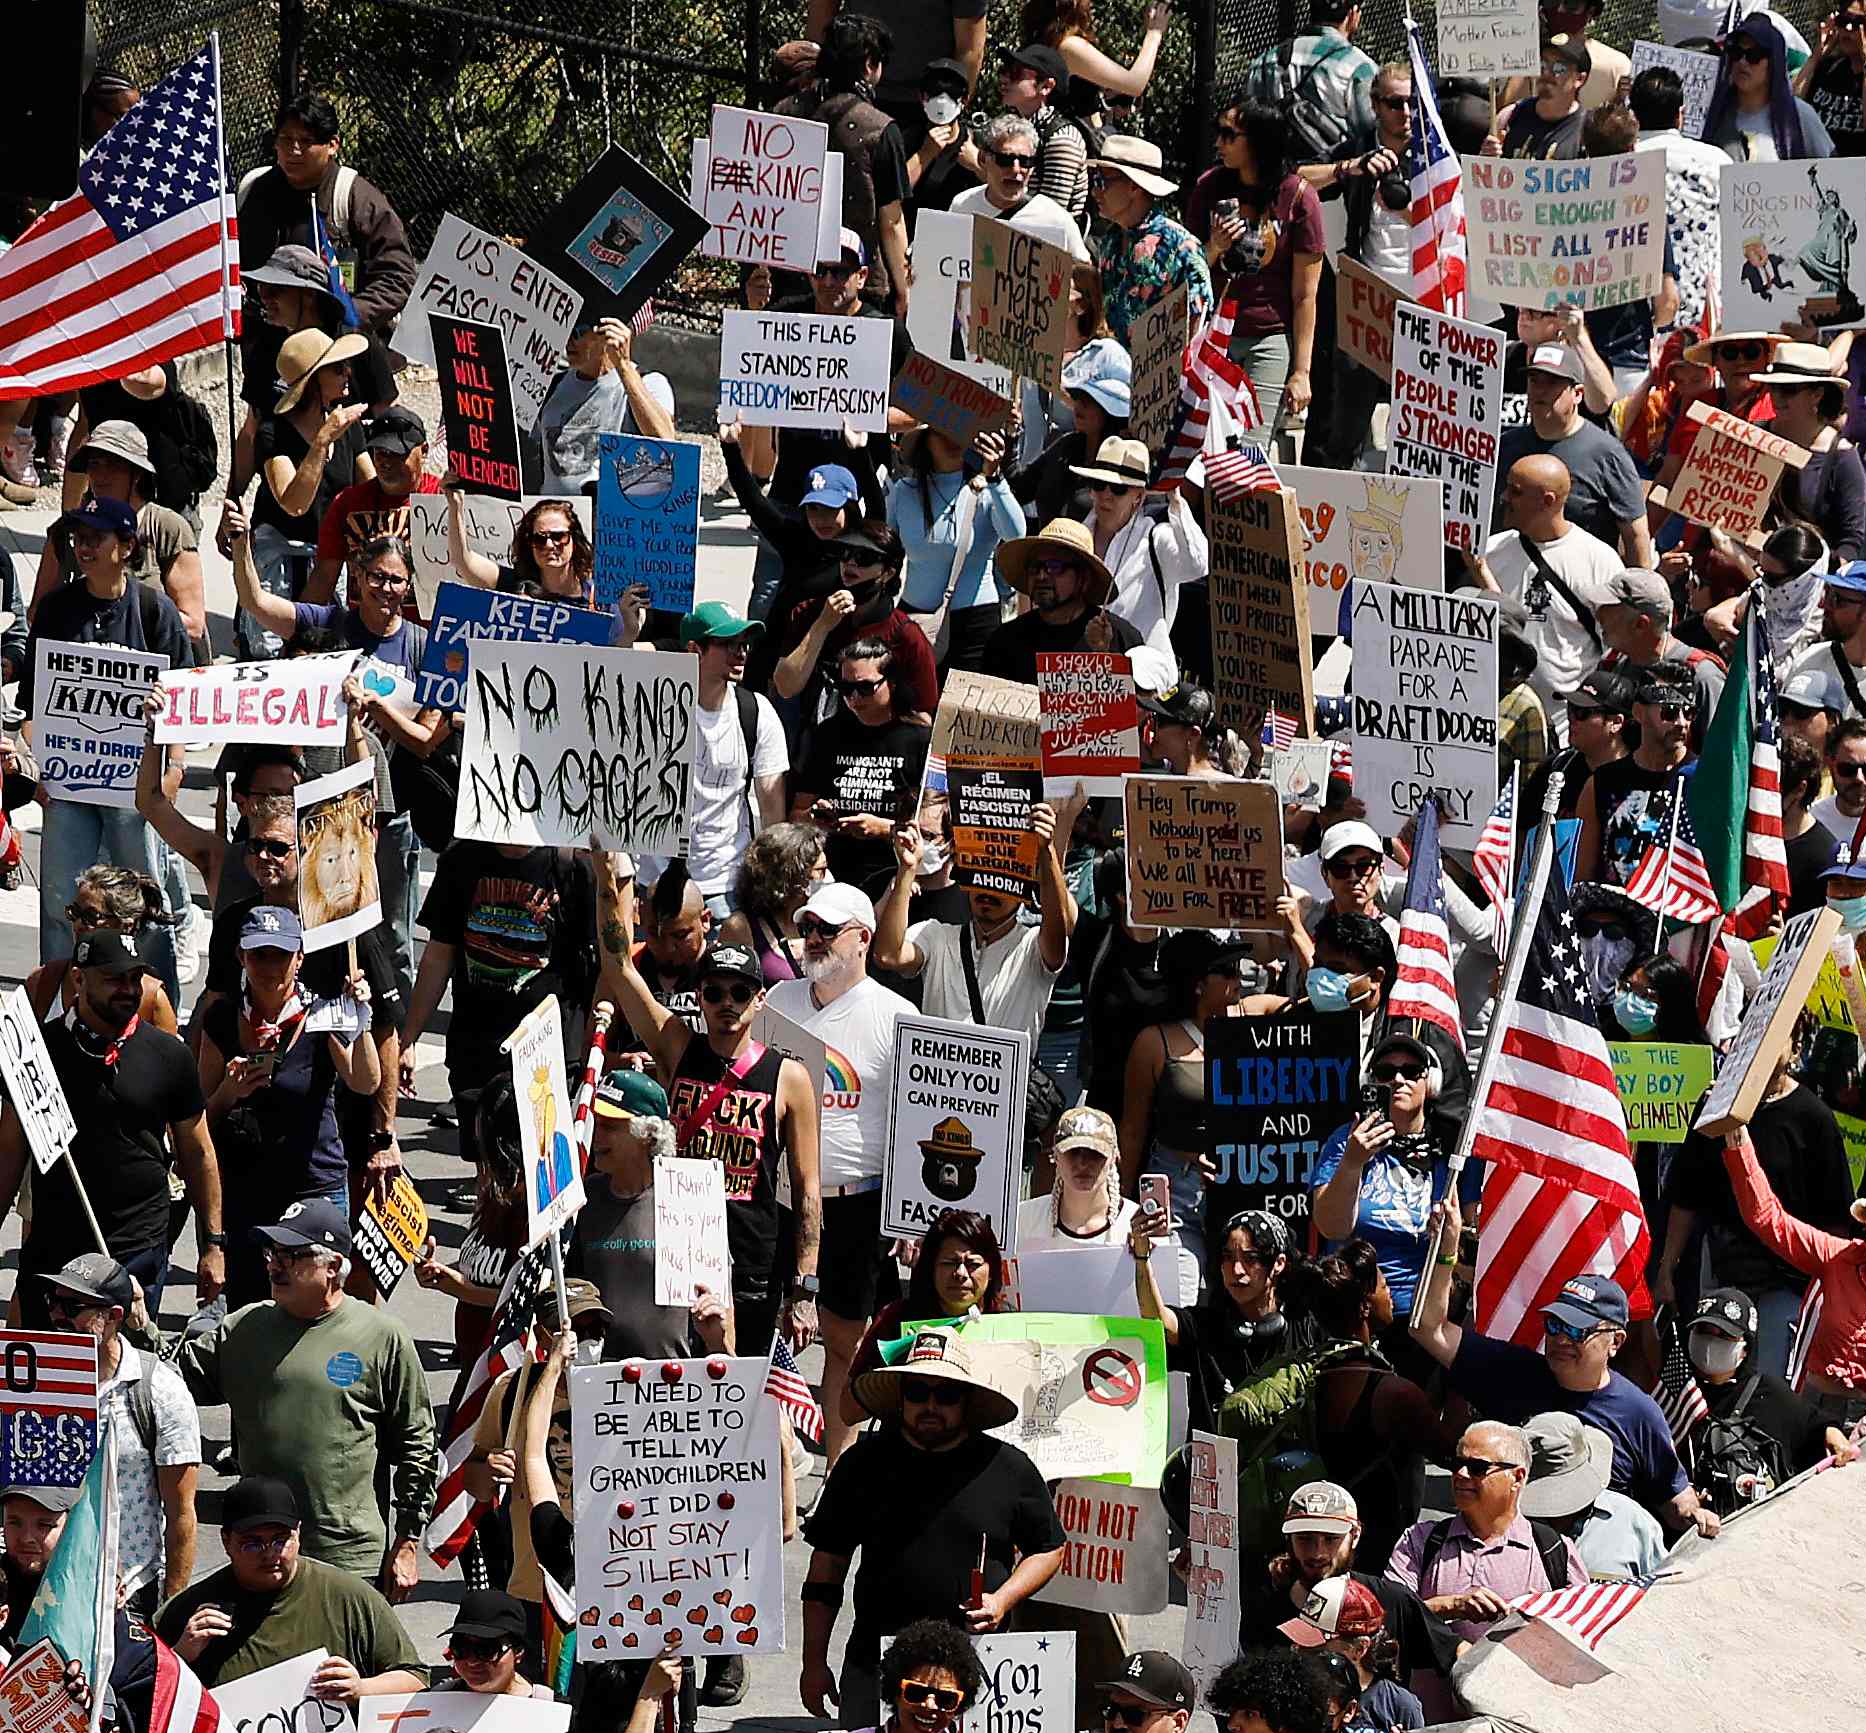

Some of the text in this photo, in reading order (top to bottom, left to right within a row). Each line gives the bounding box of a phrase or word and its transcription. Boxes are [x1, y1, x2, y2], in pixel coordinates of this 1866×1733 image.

[744, 120, 795, 156] NO
[1471, 157, 1637, 195] NO SIGN IS
[728, 201, 786, 230] ANY
[713, 223, 790, 264] TIME
[453, 328, 479, 357] WE
[758, 321, 858, 346] THIS FLAG
[1398, 312, 1498, 366] THE POWER
[454, 359, 494, 389] WILL
[740, 352, 850, 380] STANDS FOR
[720, 377, 886, 414] FREEDOM NOT FASCISM
[1394, 368, 1458, 411] PEOPLE
[458, 392, 495, 424] NOT
[470, 427, 491, 453] BE
[1398, 408, 1496, 466] STRONGER
[448, 449, 519, 492] SILENCED
[1354, 593, 1497, 644] A MILITARY
[1389, 635, 1478, 674] PARADE
[163, 686, 340, 729] ILLEGAL
[476, 661, 693, 759] NO KINGS
[1352, 697, 1498, 746] DRAFT DODGER
[468, 753, 540, 834] NO
[960, 782, 1032, 803] RÉGIMEN
[1135, 785, 1174, 821] Hey
[972, 870, 1025, 895] AHORA!
[911, 1037, 1003, 1069] REMEMBER
[1250, 1024, 1313, 1052] WITH
[1210, 1055, 1352, 1107] LIBERTY
[942, 1093, 1000, 1119] PREVENT
[608, 1520, 731, 1553] NOT STAY
[602, 1547, 750, 1590] SILENT!
